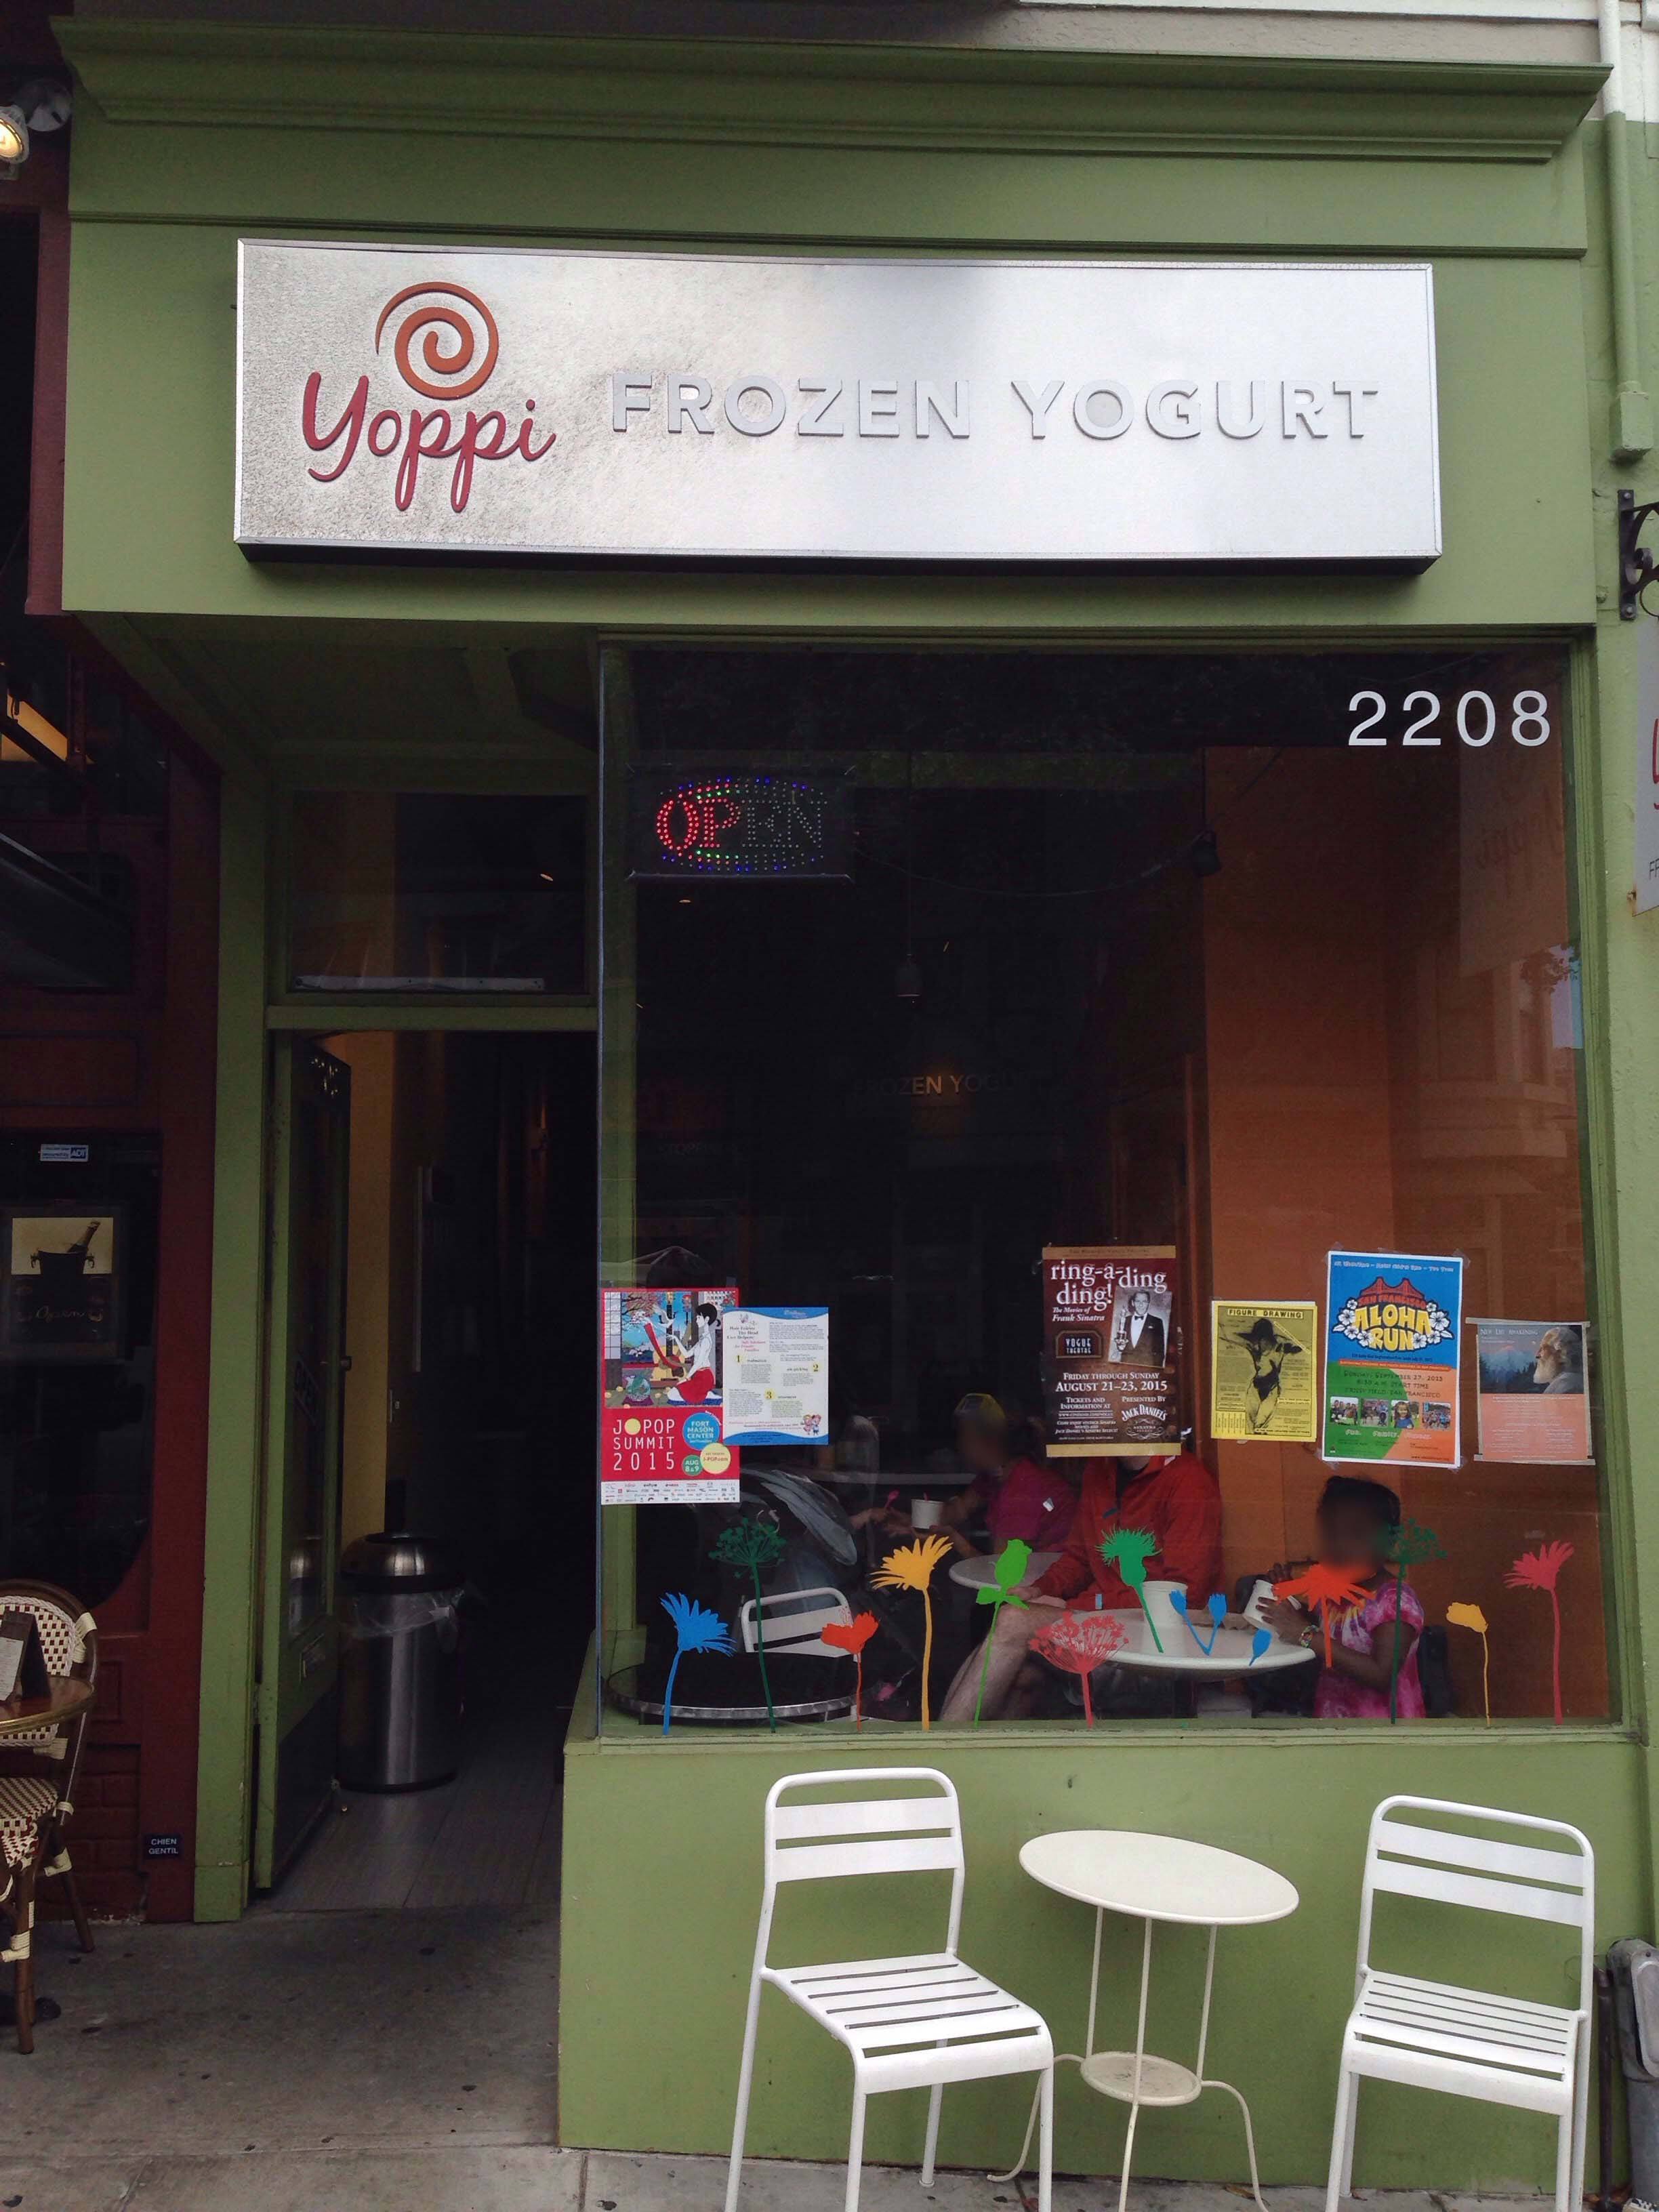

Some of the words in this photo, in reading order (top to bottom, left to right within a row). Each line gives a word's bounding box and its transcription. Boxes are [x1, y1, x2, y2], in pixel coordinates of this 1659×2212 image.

[613, 372, 970, 438] FROZEN
[1010, 379, 1378, 440] YOGURT
[1349, 690, 1551, 747] 2208
[656, 798, 828, 851] OPEN
[1056, 1281, 1112, 1311] ding!
[1263, 1310, 1302, 1318] DRAWING
[1354, 1304, 1431, 1336] ALOHA
[1065, 1338, 1091, 1347] VOGUE
[1369, 1328, 1414, 1351] RUN
[813, 1364, 819, 1372] 2
[1055, 1381, 1099, 1392] AUGUST
[1141, 1380, 1168, 1391] 2015
[766, 1391, 772, 1399] 3
[1121, 1407, 1139, 1421] JACK
[613, 1437, 675, 1450] SUMMIT
[613, 1452, 675, 1471] 2015
[150, 1838, 177, 1846] CHIEN
[148, 1847, 179, 1856] GENTIL
